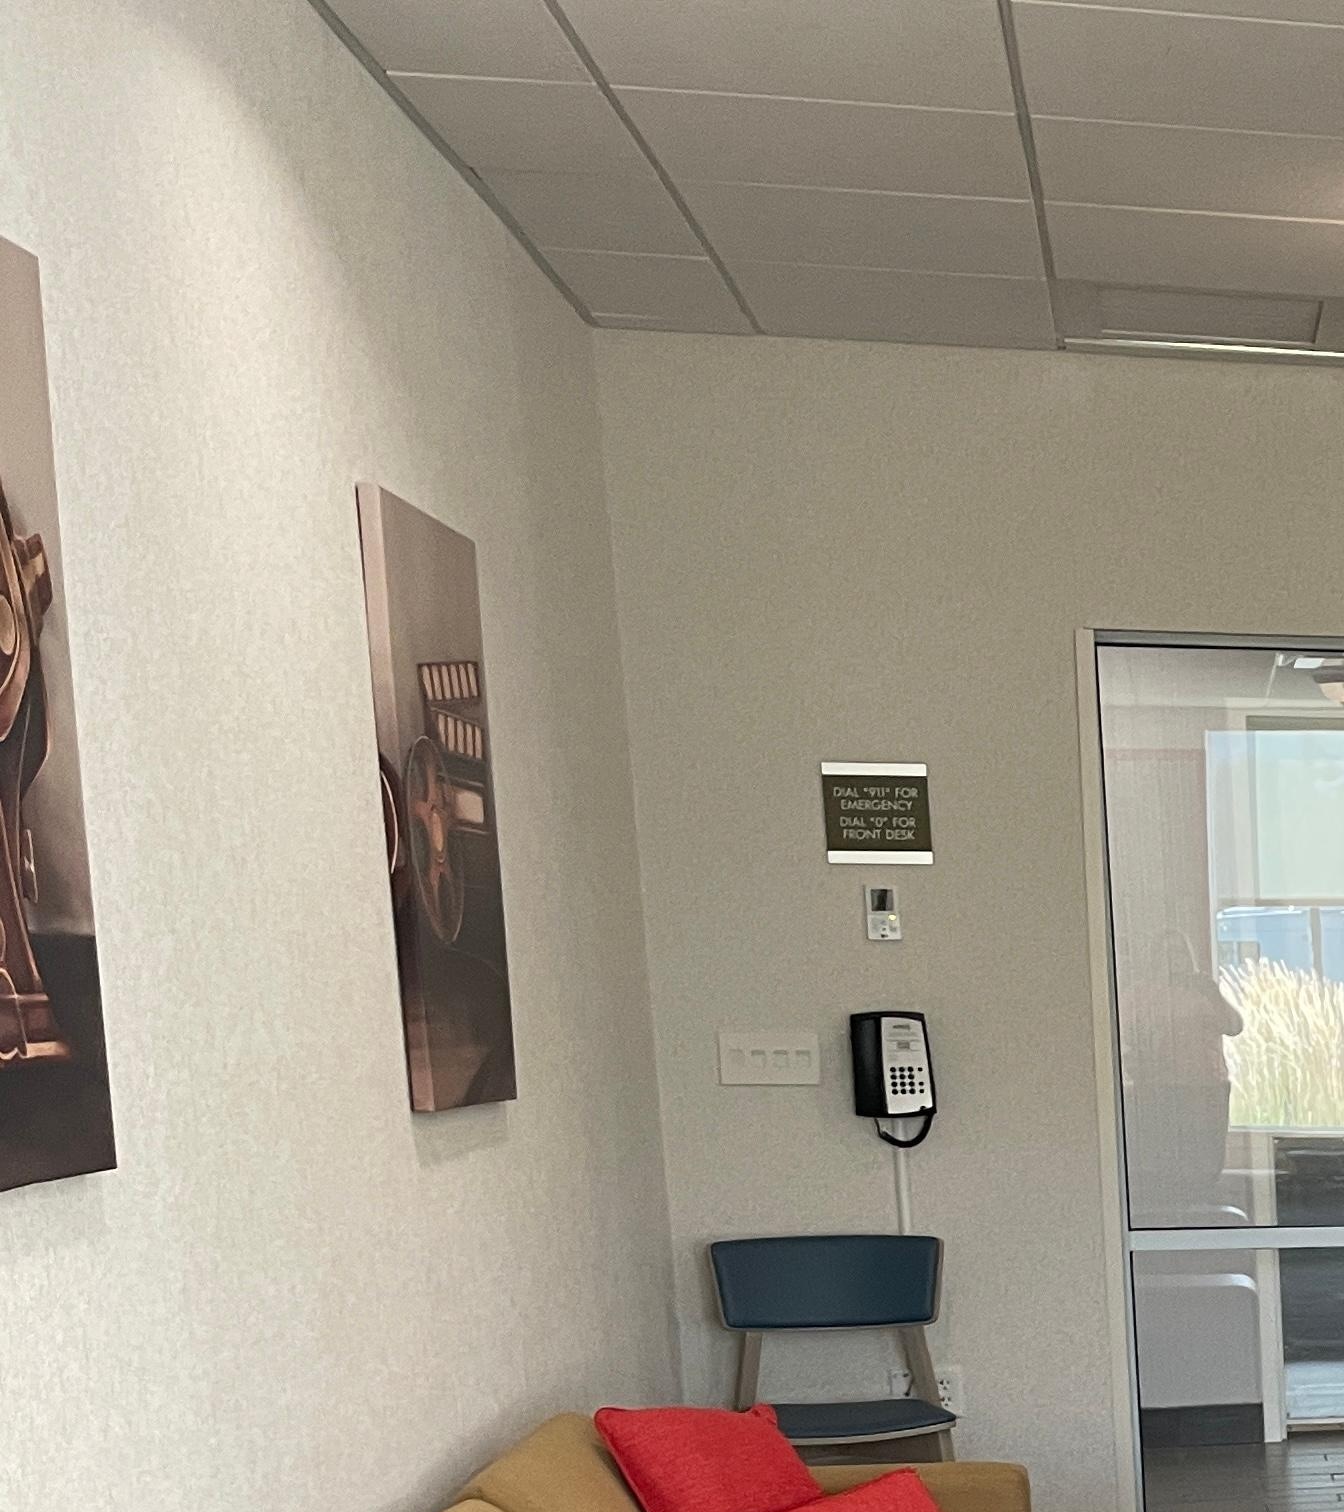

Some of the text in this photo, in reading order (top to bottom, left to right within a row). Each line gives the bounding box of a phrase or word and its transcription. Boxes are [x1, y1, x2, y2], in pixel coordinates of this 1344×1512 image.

[832, 786, 859, 798] DIAL
[894, 787, 918, 798] FOR
[840, 799, 913, 811] EMERGENCY
[839, 816, 867, 828] DIAL
[892, 816, 917, 828] FOR
[842, 828, 916, 841] FRONT DESK
